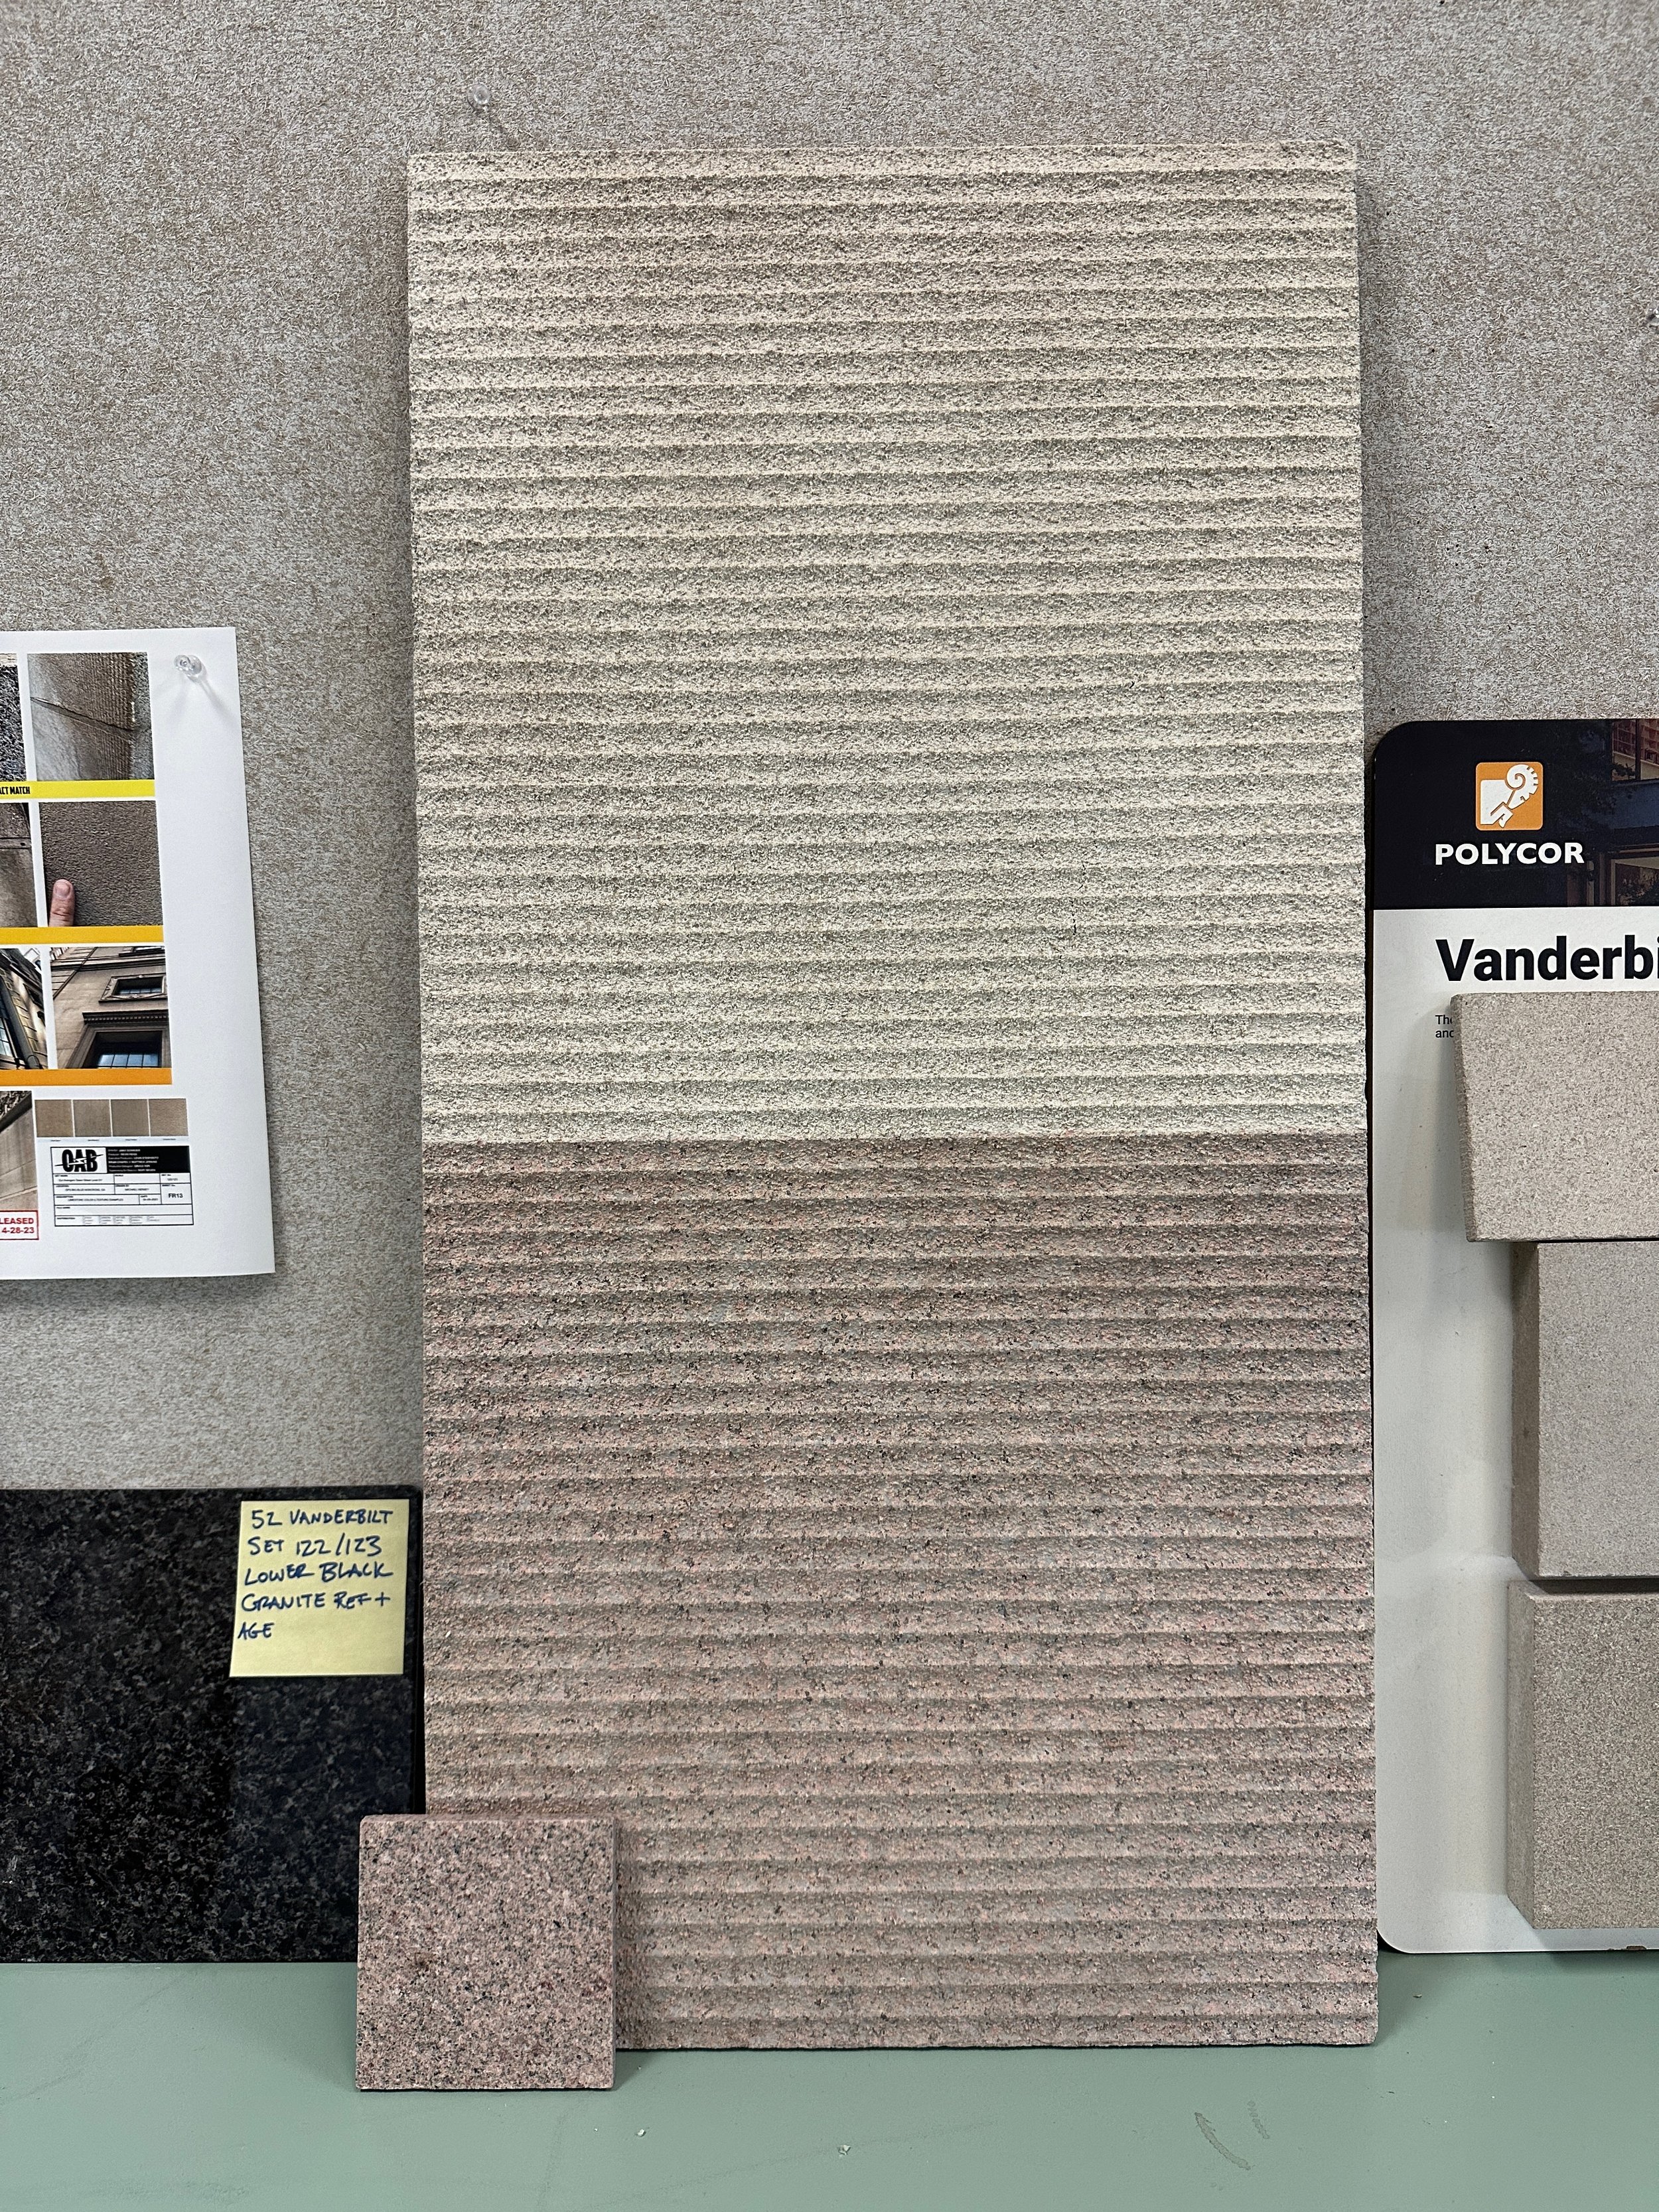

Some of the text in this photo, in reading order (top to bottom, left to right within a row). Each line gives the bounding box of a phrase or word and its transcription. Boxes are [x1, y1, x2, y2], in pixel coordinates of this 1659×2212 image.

[1435, 842, 1585, 865] POLYCOR
[252, 1509, 394, 1529] 52 VANDERBILT
[244, 1561, 394, 1585] LOWER BLACK
[242, 1592, 326, 1612] GRANITE
[374, 1591, 391, 1607] +
[238, 1621, 275, 1640] AGE
